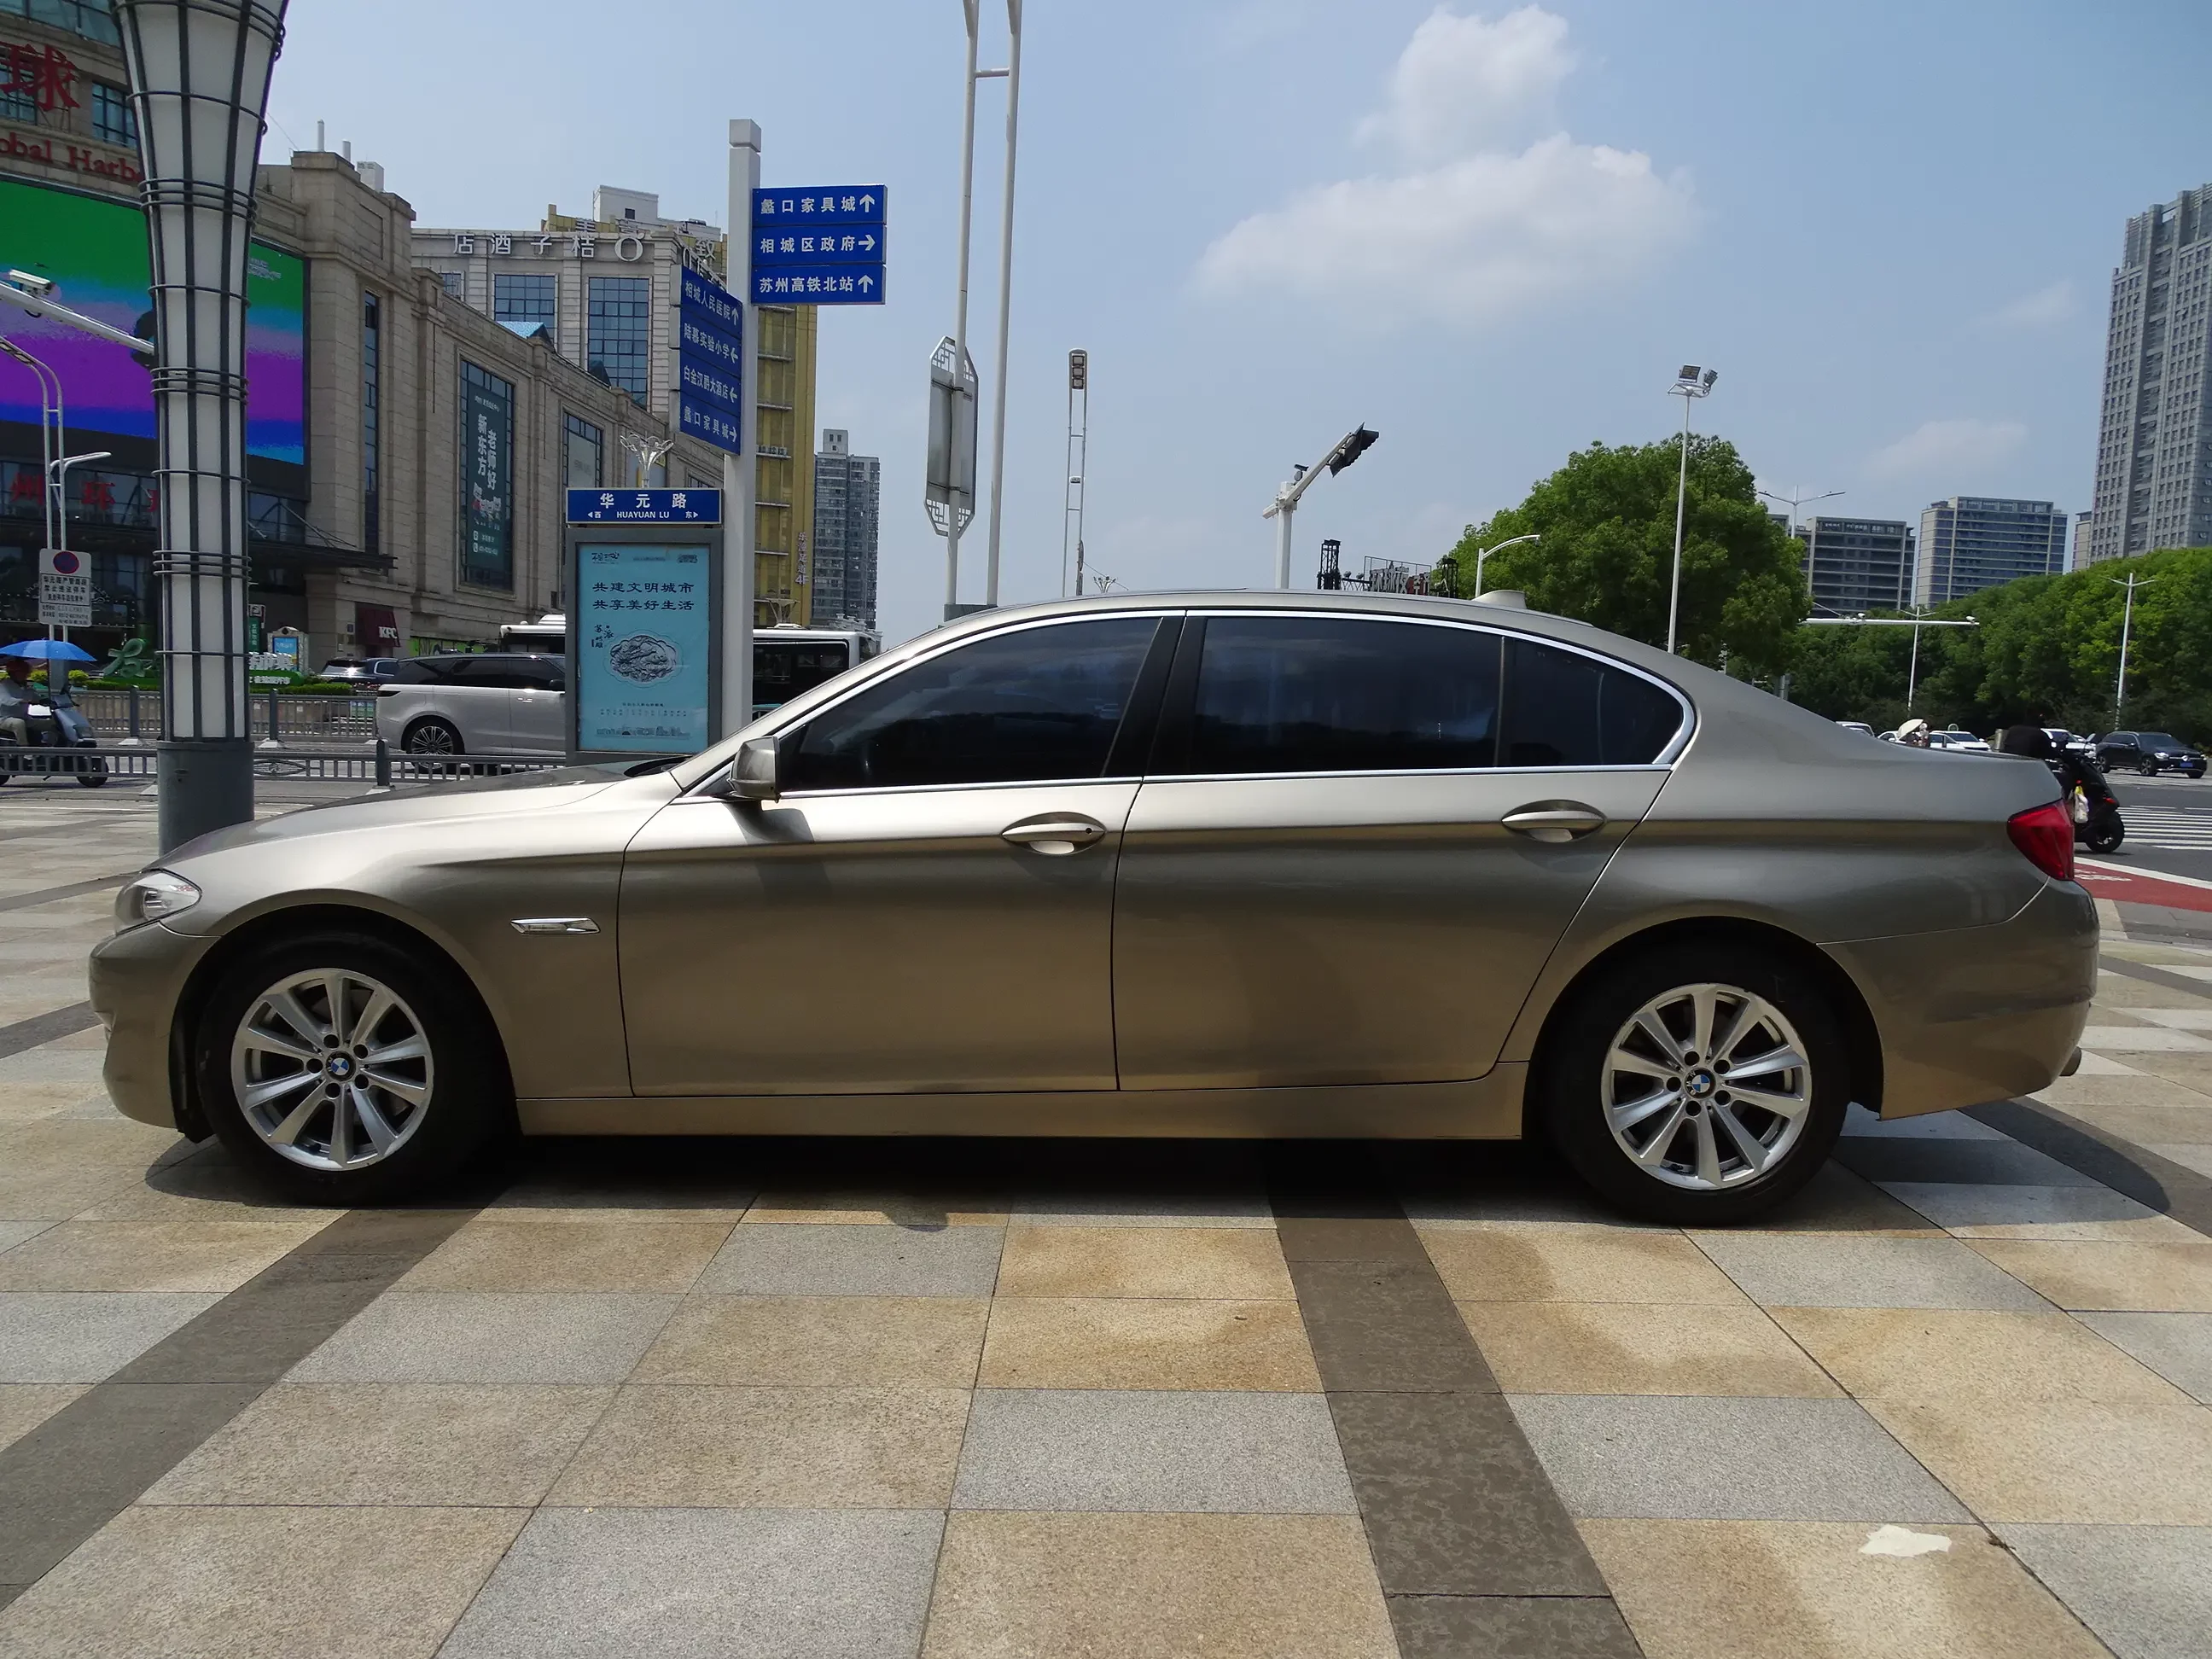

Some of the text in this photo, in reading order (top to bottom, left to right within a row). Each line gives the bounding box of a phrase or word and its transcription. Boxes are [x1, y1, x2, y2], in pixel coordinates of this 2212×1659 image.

[67, 146, 143, 182] Harb
[760, 195, 856, 214] 蠡口家具城
[760, 236, 855, 253] 相城区政府
[760, 276, 853, 293] 苏州高铁北站
[684, 280, 731, 321] 相城人民医院
[684, 323, 730, 359] 陆慕实验小学
[684, 365, 729, 399] 白金汉爵大酒店
[684, 405, 729, 439] 蠡口家具城
[478, 413, 487, 476] 新东方
[487, 429, 497, 491] 老师好
[600, 492, 687, 509] 华元路
[592, 582, 695, 594] 共建文明城市
[592, 599, 695, 611] 共享美好生活
[378, 626, 398, 639] KFC
